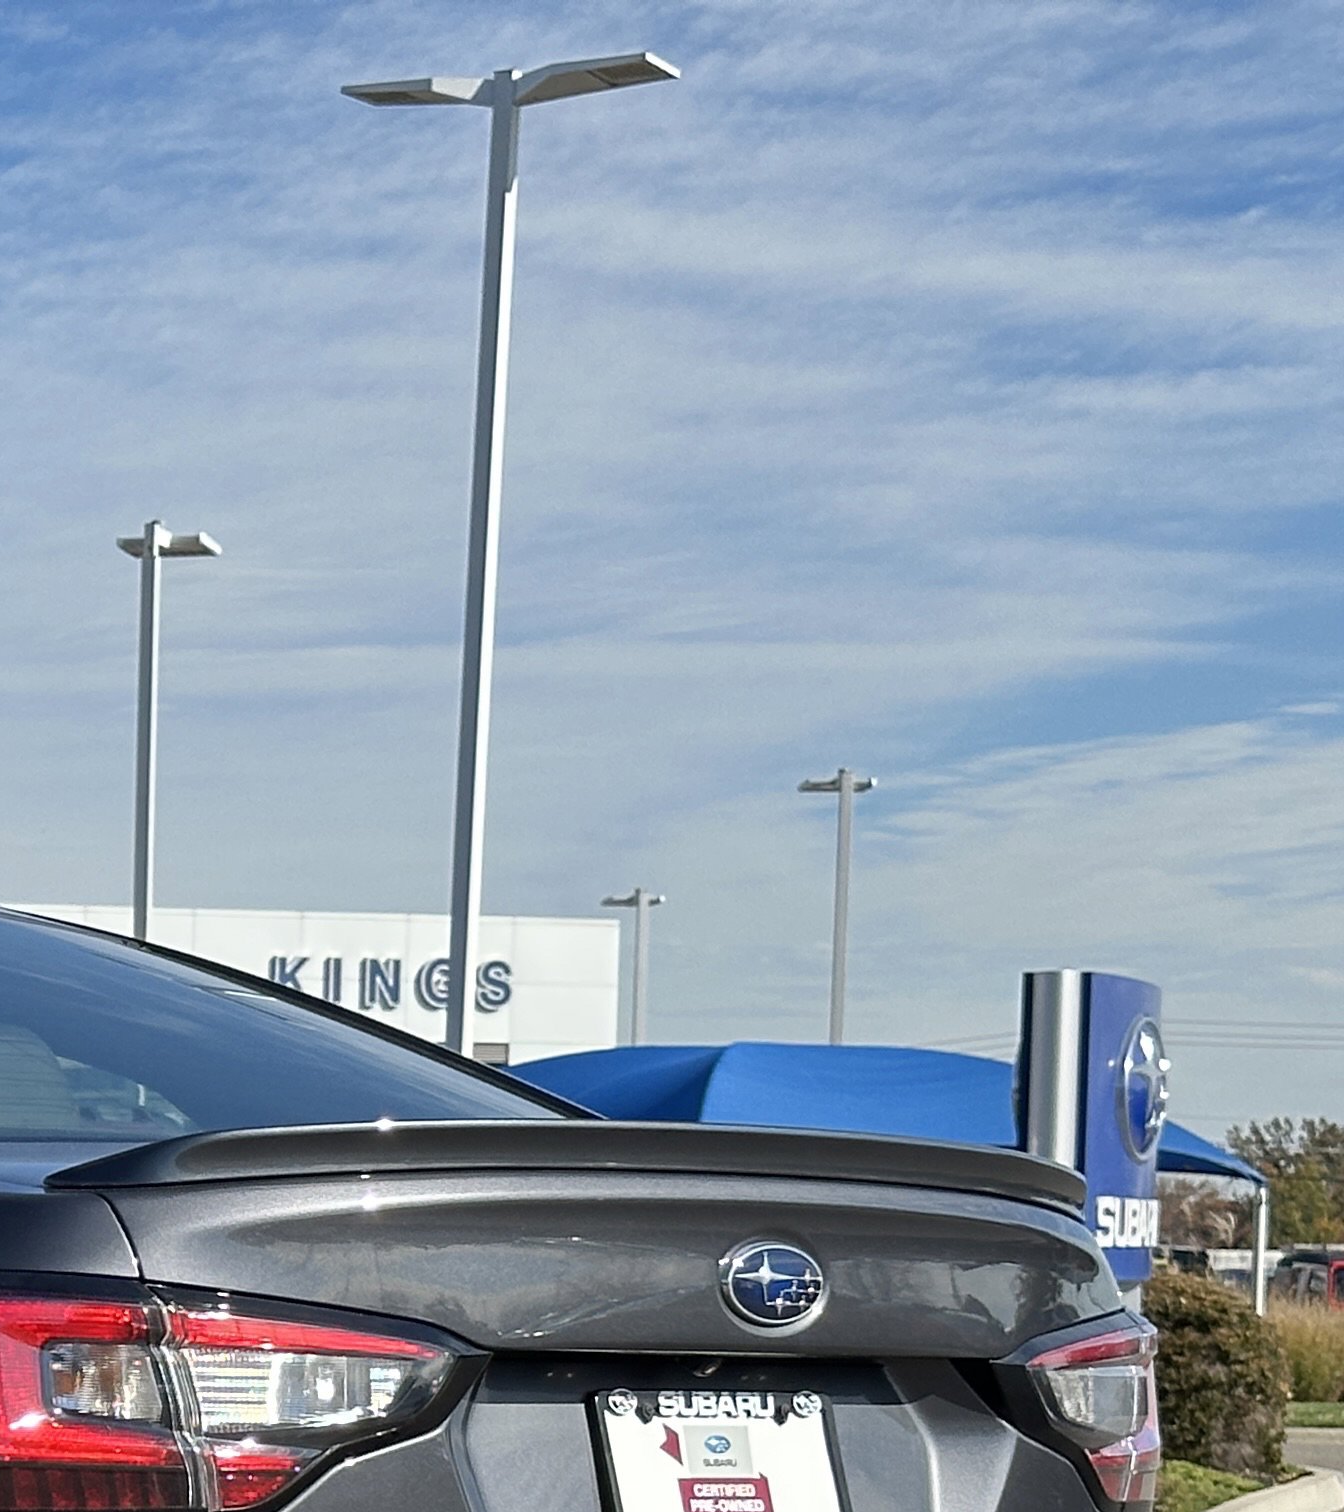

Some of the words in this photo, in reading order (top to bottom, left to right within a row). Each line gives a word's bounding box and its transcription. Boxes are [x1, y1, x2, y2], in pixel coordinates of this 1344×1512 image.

[268, 955, 513, 1013] KINGS
[1094, 1196, 1158, 1248] SUBAR
[657, 1389, 775, 1419] SUBARU
[703, 1459, 737, 1467] SUBARU
[693, 1483, 756, 1498] CERTIFIED
[689, 1498, 765, 1512] PRE-OWNED
